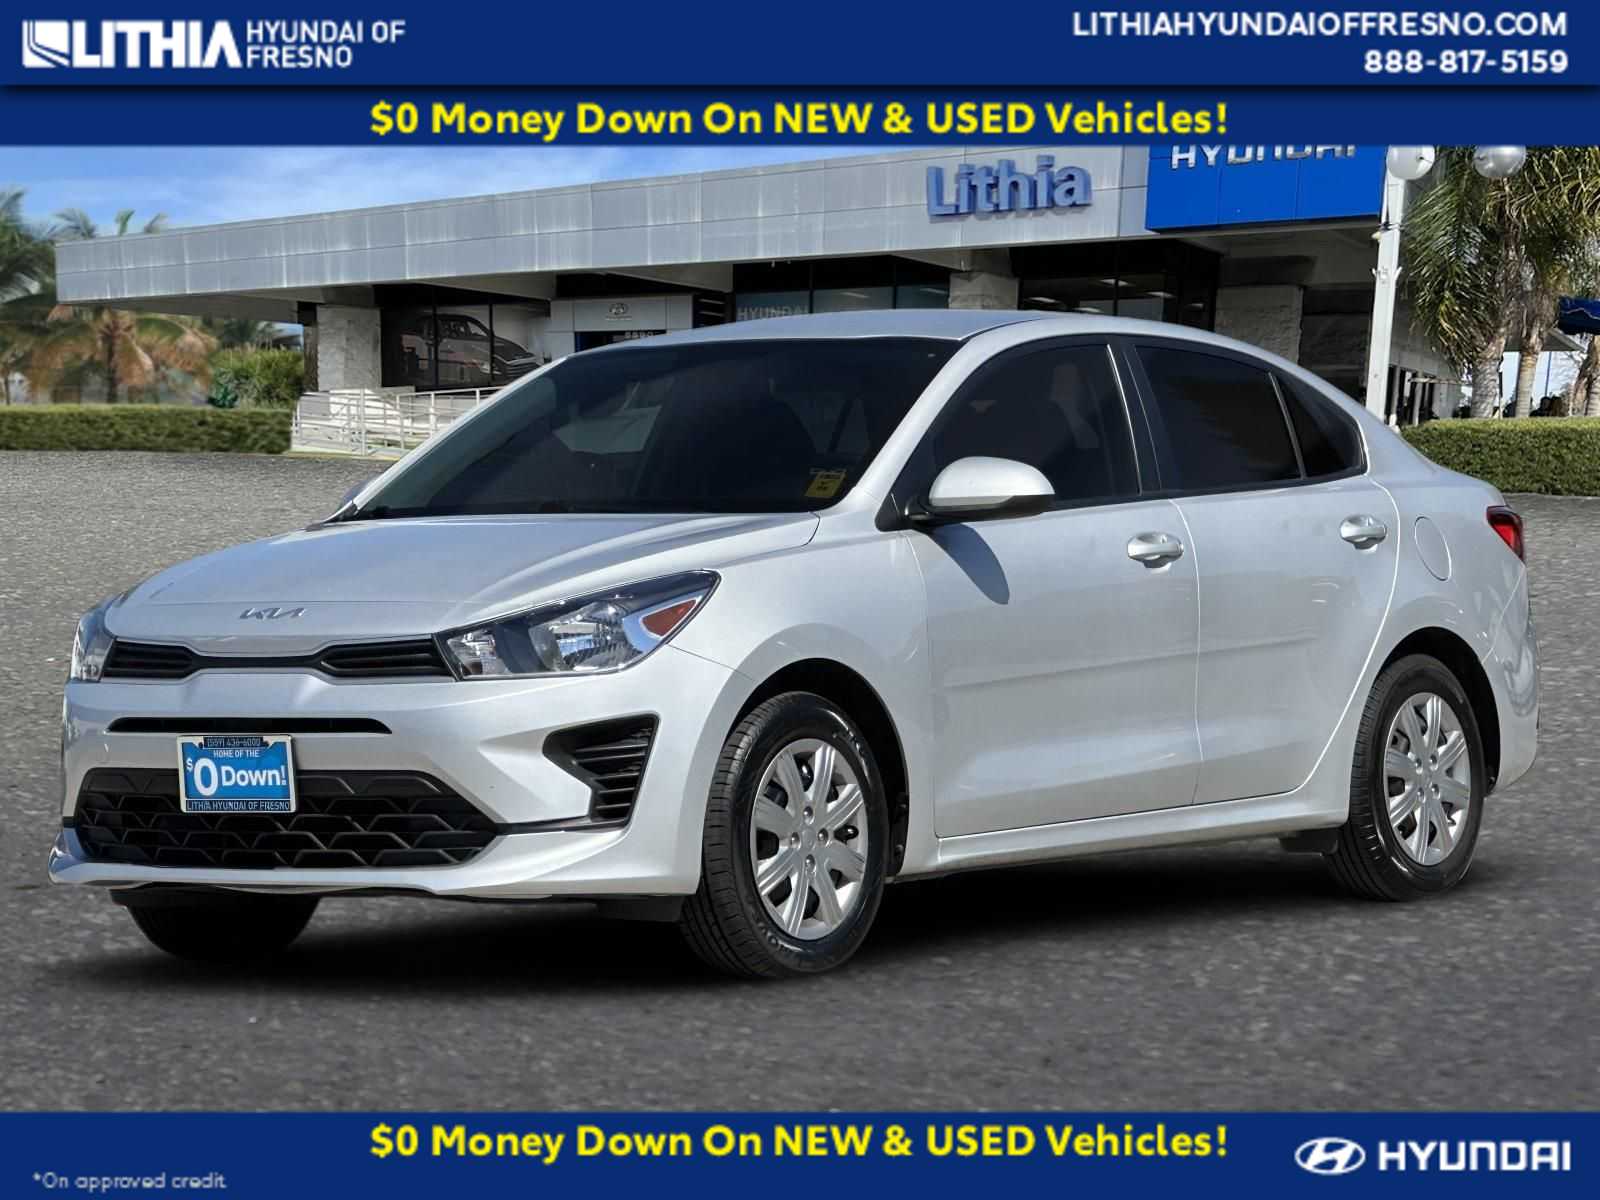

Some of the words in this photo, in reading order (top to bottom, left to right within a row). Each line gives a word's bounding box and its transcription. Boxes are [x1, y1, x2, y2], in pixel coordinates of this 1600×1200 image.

[926, 155, 1092, 217] Lithia
[239, 607, 305, 620] KIA
[213, 749, 234, 758] HOME
[235, 749, 244, 758] OF
[245, 749, 260, 758] THE
[220, 765, 287, 786] Down!
[212, 800, 246, 811] HYUNDAI
[248, 800, 258, 810] OF
[260, 800, 290, 810] FRESNO
